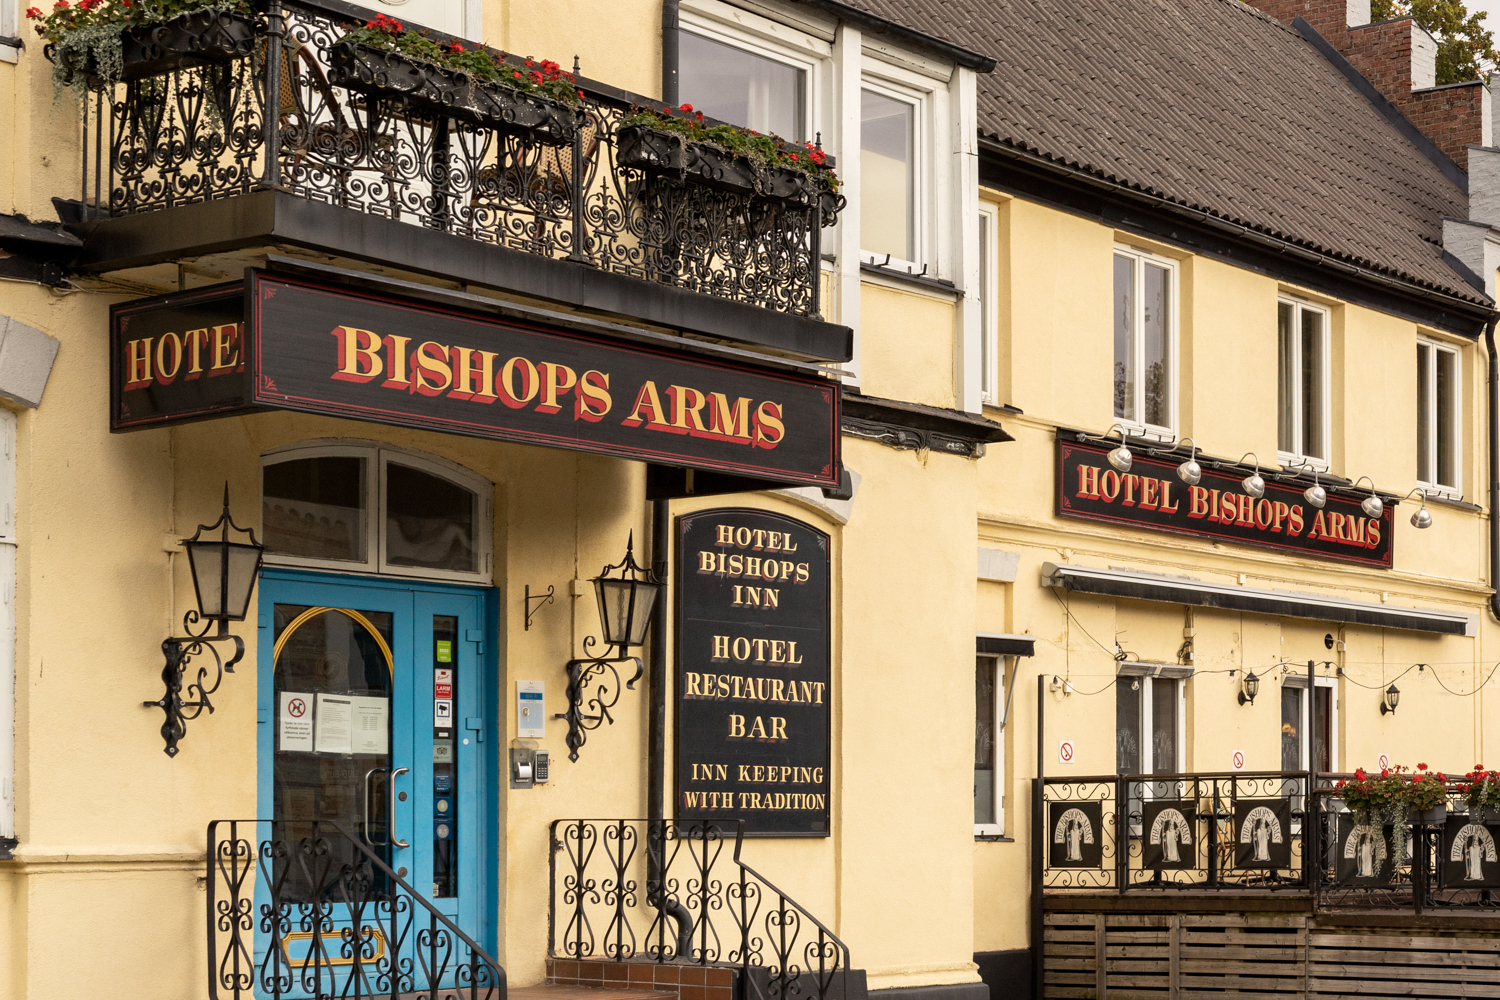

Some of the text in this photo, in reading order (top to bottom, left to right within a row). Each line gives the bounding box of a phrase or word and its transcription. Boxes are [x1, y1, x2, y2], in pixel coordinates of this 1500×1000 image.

[127, 322, 246, 384] HOTE
[337, 325, 786, 445] BISHOPS ARMS
[1078, 464, 1381, 548] HOTEL BISHOPS ARMS
[717, 524, 798, 553] HOTEL
[699, 551, 810, 584] BISHOPS
[733, 585, 780, 608] INN
[713, 635, 803, 665] HOTEL
[686, 672, 825, 705] RESTAURANT
[728, 714, 788, 740] BAR
[691, 763, 824, 785] INN KEEPING
[685, 791, 825, 811] WITH TRADITION
[1056, 810, 1091, 840] THE BISHOPS ARMS
[1151, 810, 1191, 842] THE BISHOPS ARMS
[1242, 808, 1280, 841] THE BISHOPS ARMS
[1346, 841, 1356, 855] THE
[1453, 842, 1461, 858] THE
[1484, 836, 1495, 858] ARMS
